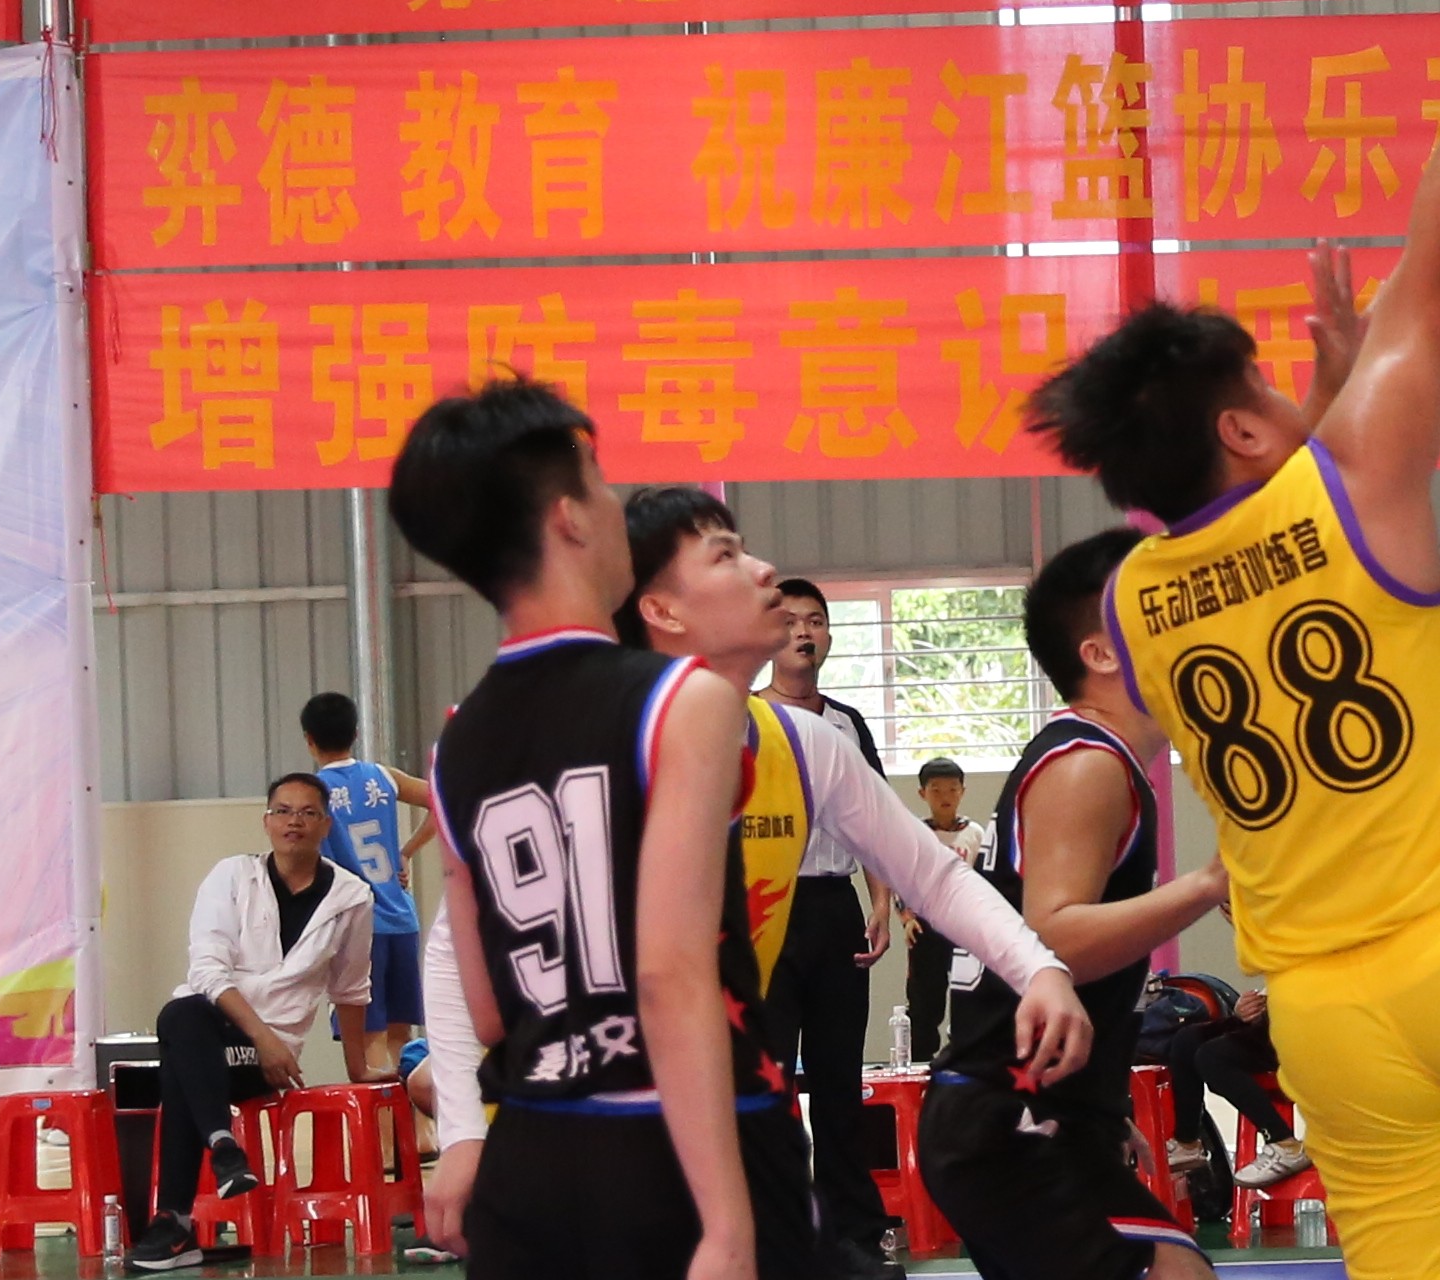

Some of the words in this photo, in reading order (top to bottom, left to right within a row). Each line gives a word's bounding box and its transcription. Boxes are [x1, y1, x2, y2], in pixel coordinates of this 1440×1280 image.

[143, 75, 360, 247] 弈德
[399, 66, 618, 242] 教育
[1171, 599, 1413, 832] 88
[348, 820, 393, 883] 5
[474, 765, 626, 1017] 91
